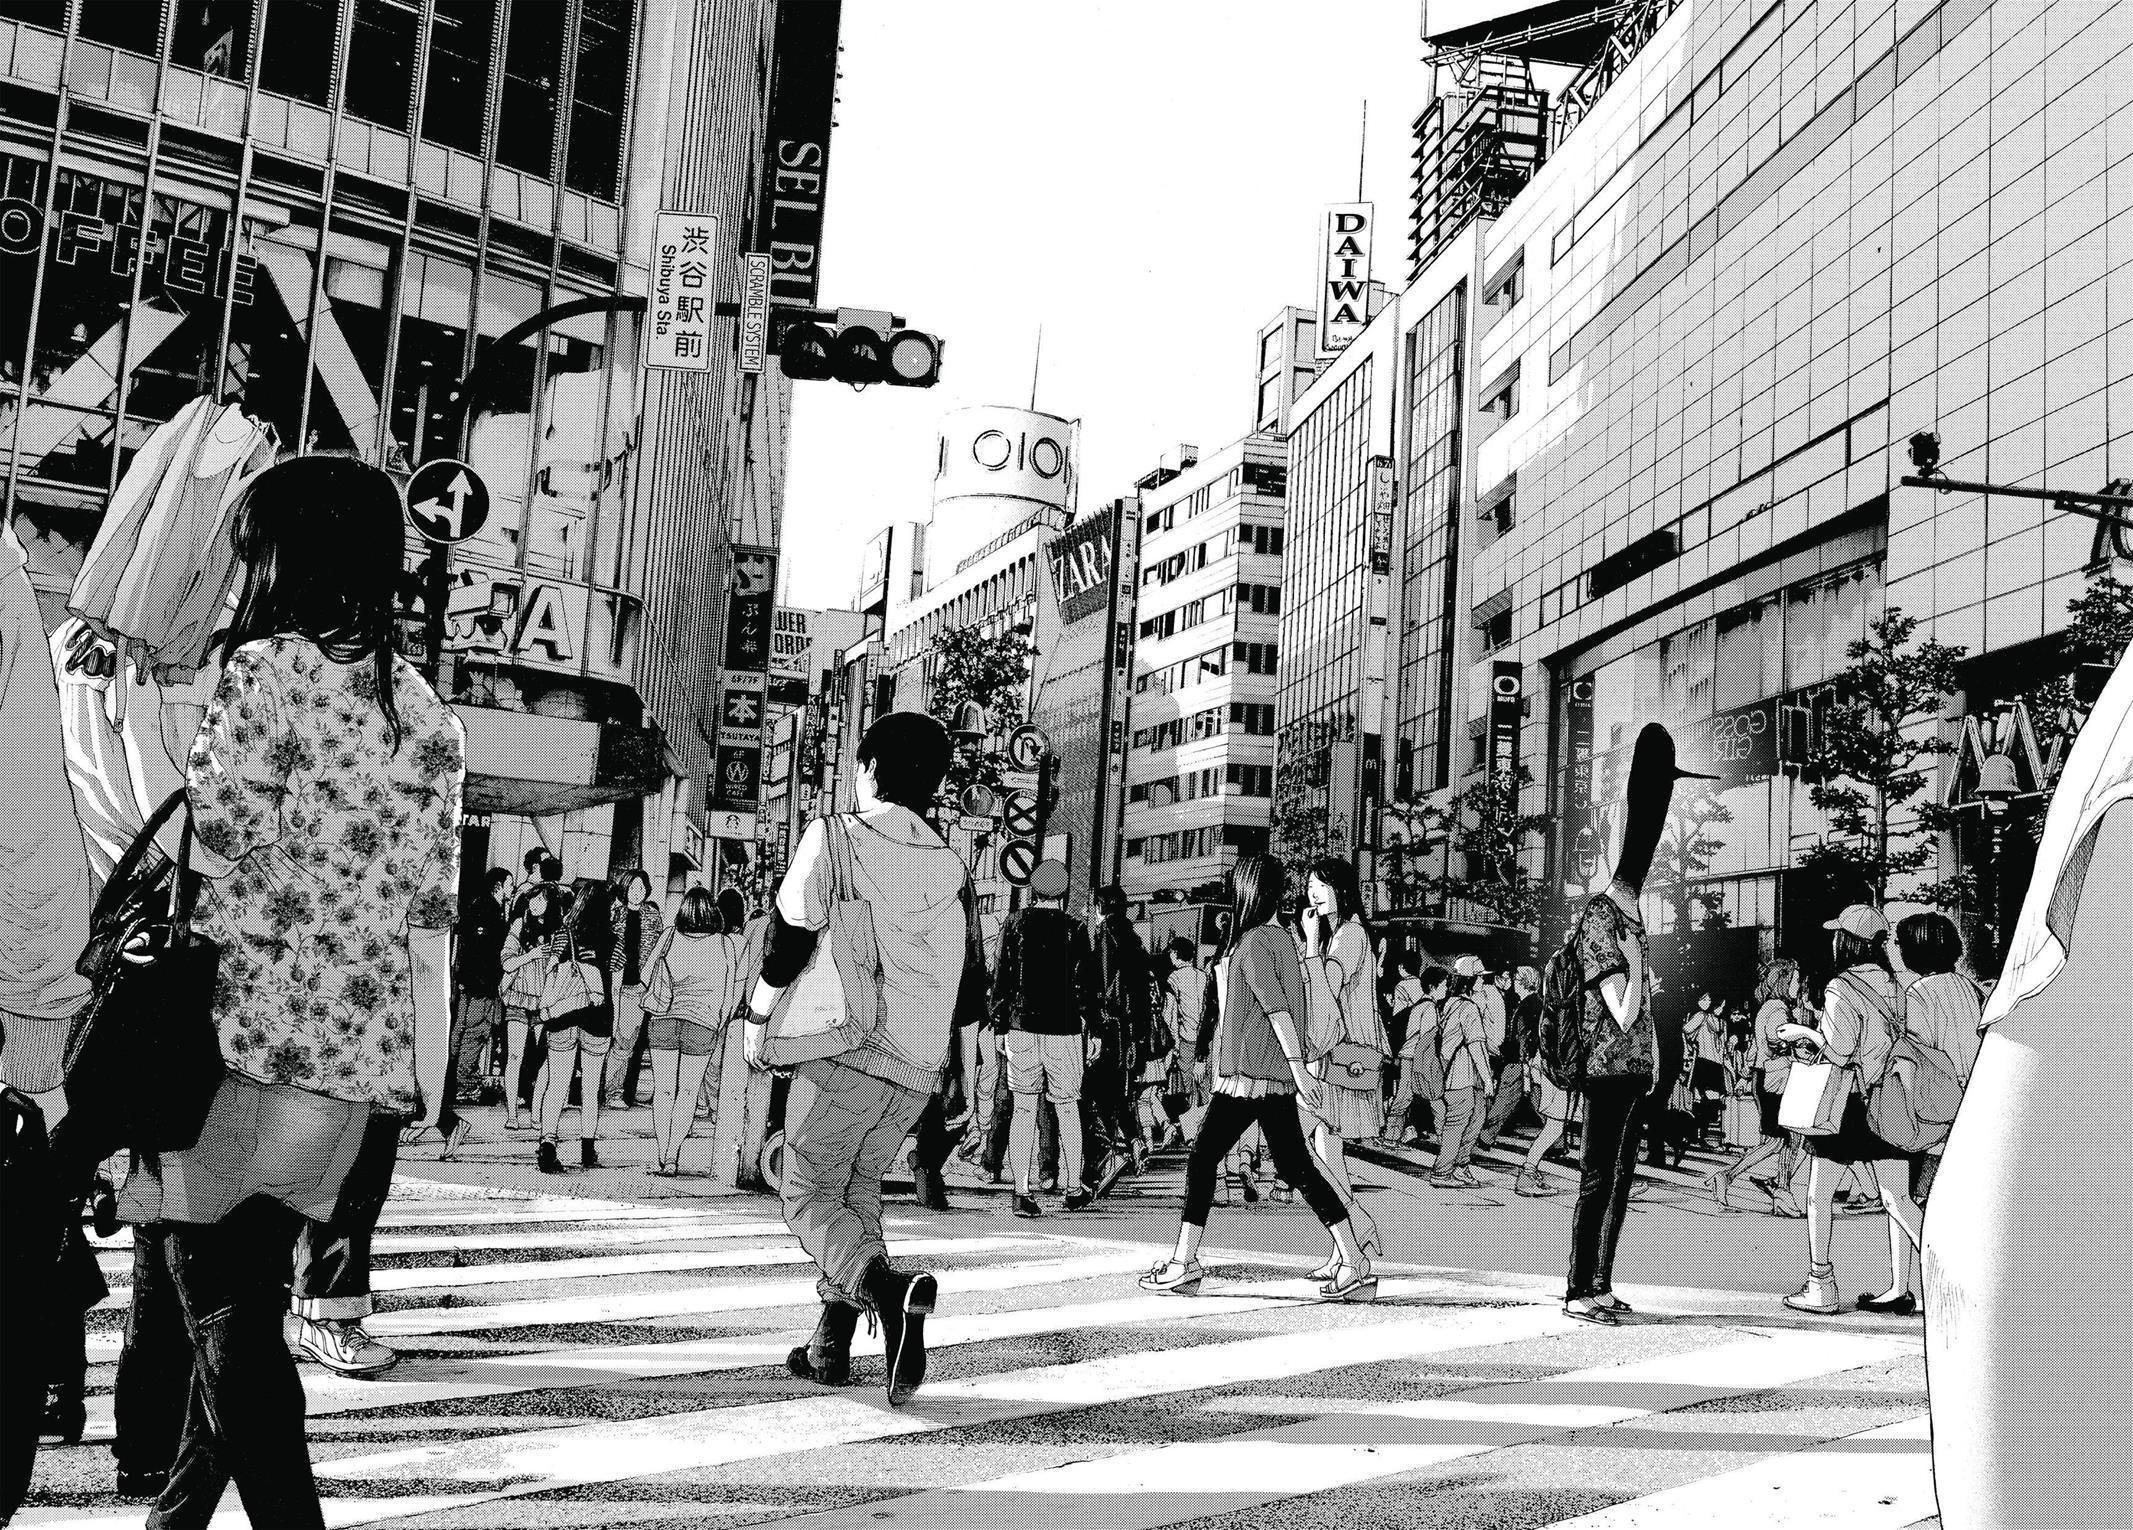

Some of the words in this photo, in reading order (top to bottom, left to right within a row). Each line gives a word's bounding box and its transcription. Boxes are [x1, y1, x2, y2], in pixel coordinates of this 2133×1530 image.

[656, 244, 677, 305] Shibuya
[675, 226, 709, 359] 渋谷駅前
[746, 259, 765, 320] SCRAMBLE
[1328, 213, 1367, 324] DAIWA
[655, 310, 672, 340] Sta.
[744, 322, 762, 366] SYSTEM
[728, 694, 758, 724] 本
[720, 730, 761, 743] TSUTAYA
